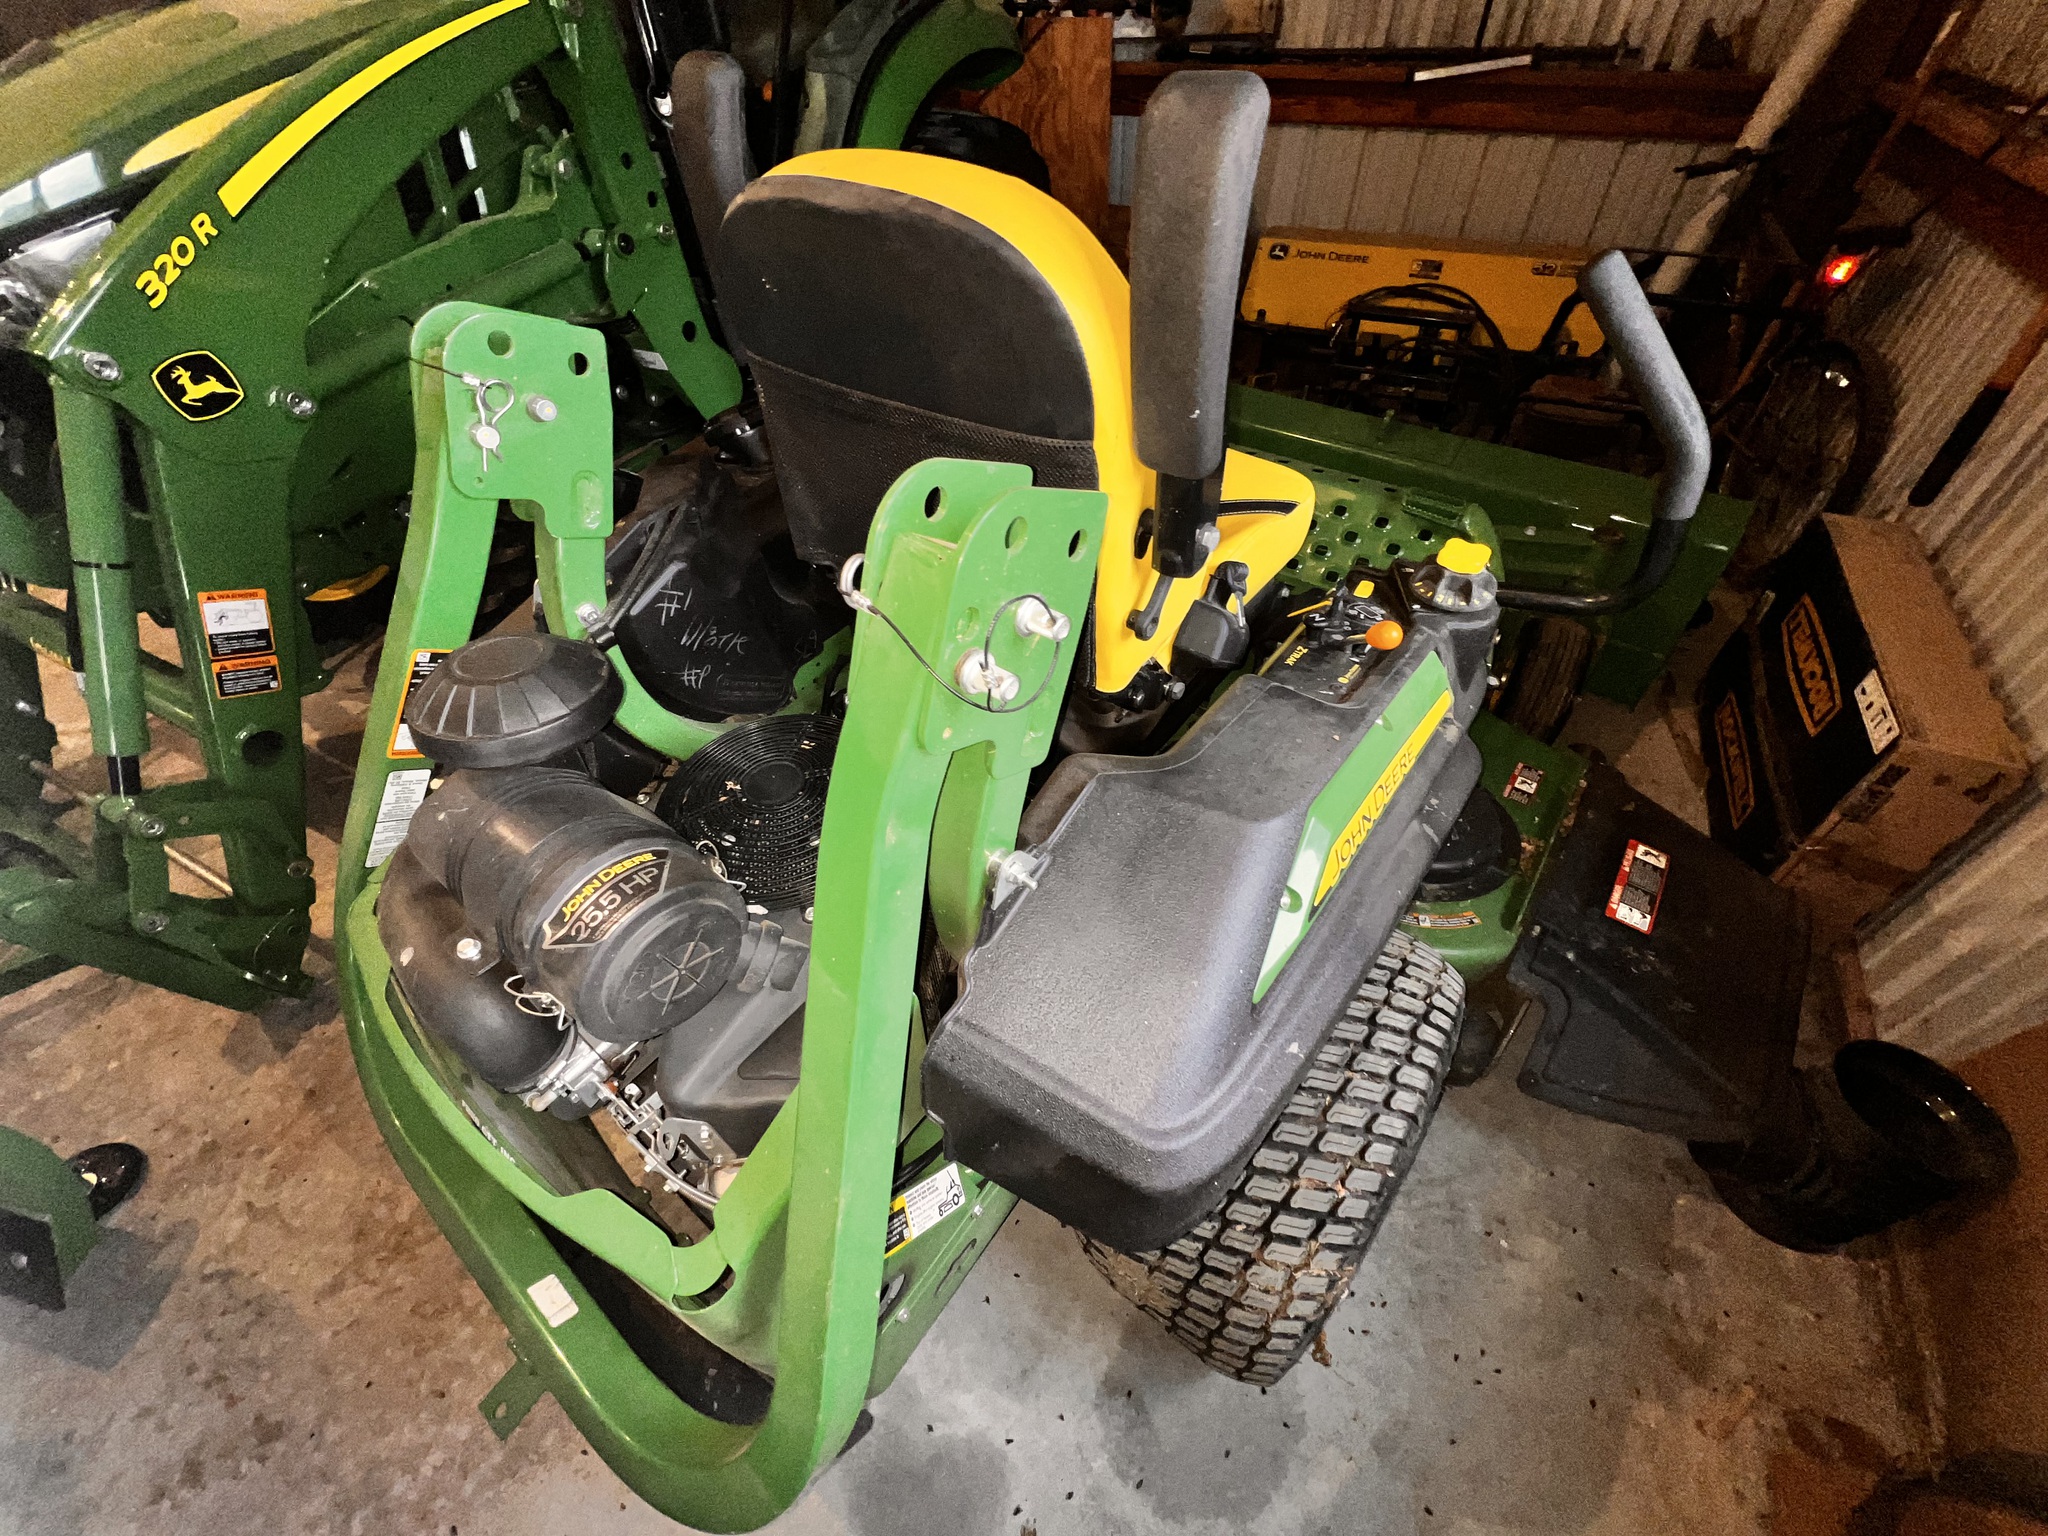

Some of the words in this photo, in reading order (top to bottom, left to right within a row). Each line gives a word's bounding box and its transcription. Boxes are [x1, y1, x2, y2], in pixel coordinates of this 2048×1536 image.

[135, 235, 196, 309] 320
[190, 212, 219, 247] R
[1293, 248, 1327, 261] JOHN
[1328, 251, 1370, 264] DEERE
[1332, 805, 1373, 881] JOHN
[1373, 743, 1417, 812] DEERE
[562, 878, 602, 923] JOHN
[598, 852, 657, 883] DEERE
[571, 889, 622, 942] 25.5
[618, 866, 659, 895] HP
